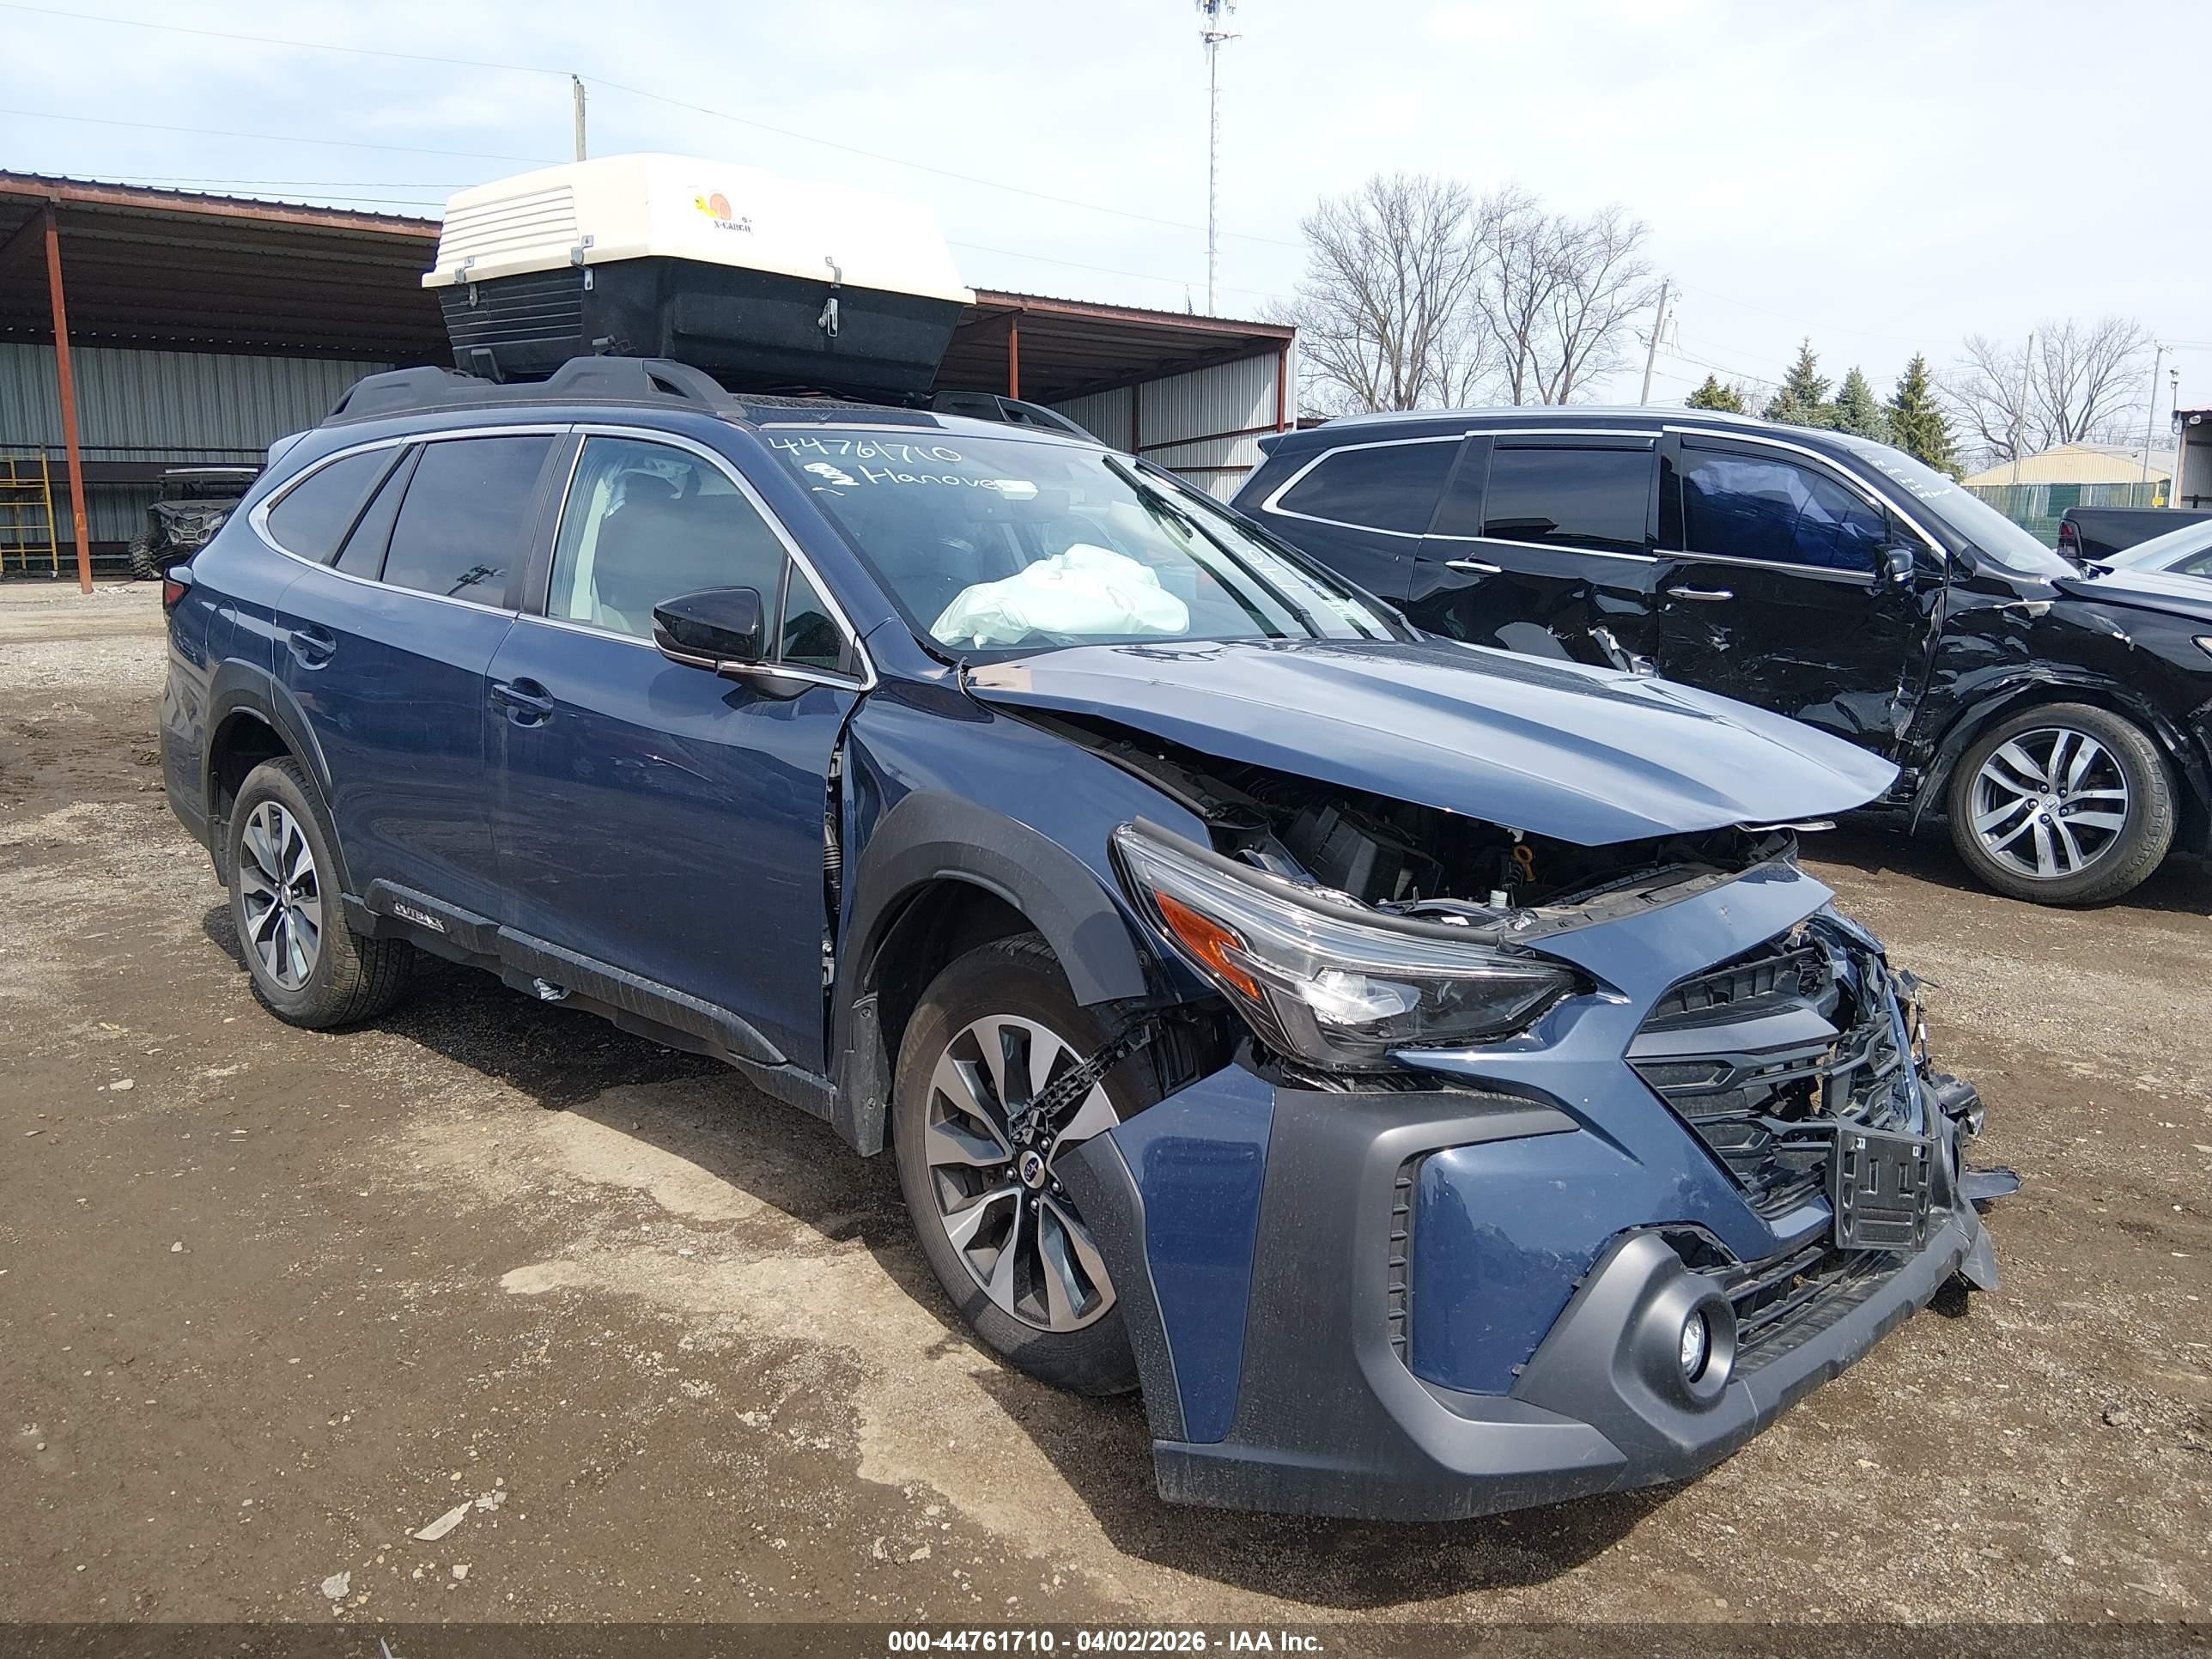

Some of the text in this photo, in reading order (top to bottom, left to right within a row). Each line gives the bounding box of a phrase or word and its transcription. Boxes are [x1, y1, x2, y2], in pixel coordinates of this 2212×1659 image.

[714, 220, 751, 233] X-CARGO
[768, 437, 962, 463] 44761710
[857, 465, 1005, 491] Hanove
[395, 902, 445, 931] OUTBACK
